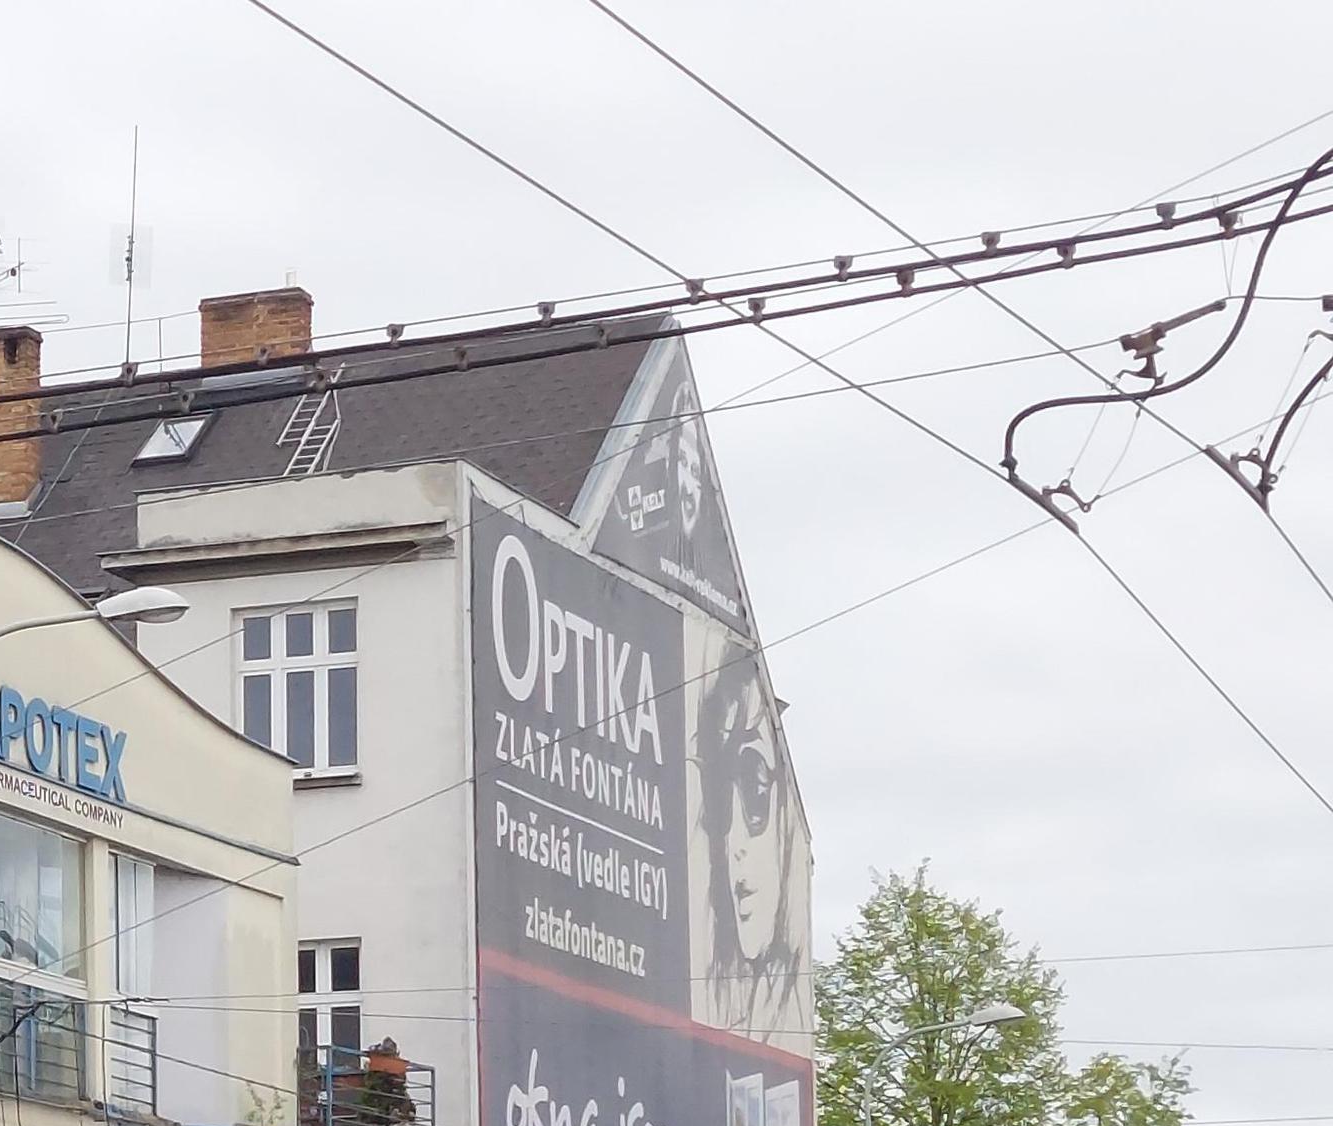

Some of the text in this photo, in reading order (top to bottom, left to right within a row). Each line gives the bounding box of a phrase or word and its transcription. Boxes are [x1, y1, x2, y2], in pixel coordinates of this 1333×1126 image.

[75, 799, 123, 829] COMPANY
[495, 711, 664, 831] ZLATÁ FONTÁNA
[496, 801, 667, 920] Pražská (vedle IGY)
[525, 897, 646, 978] zlatafontana.cz
